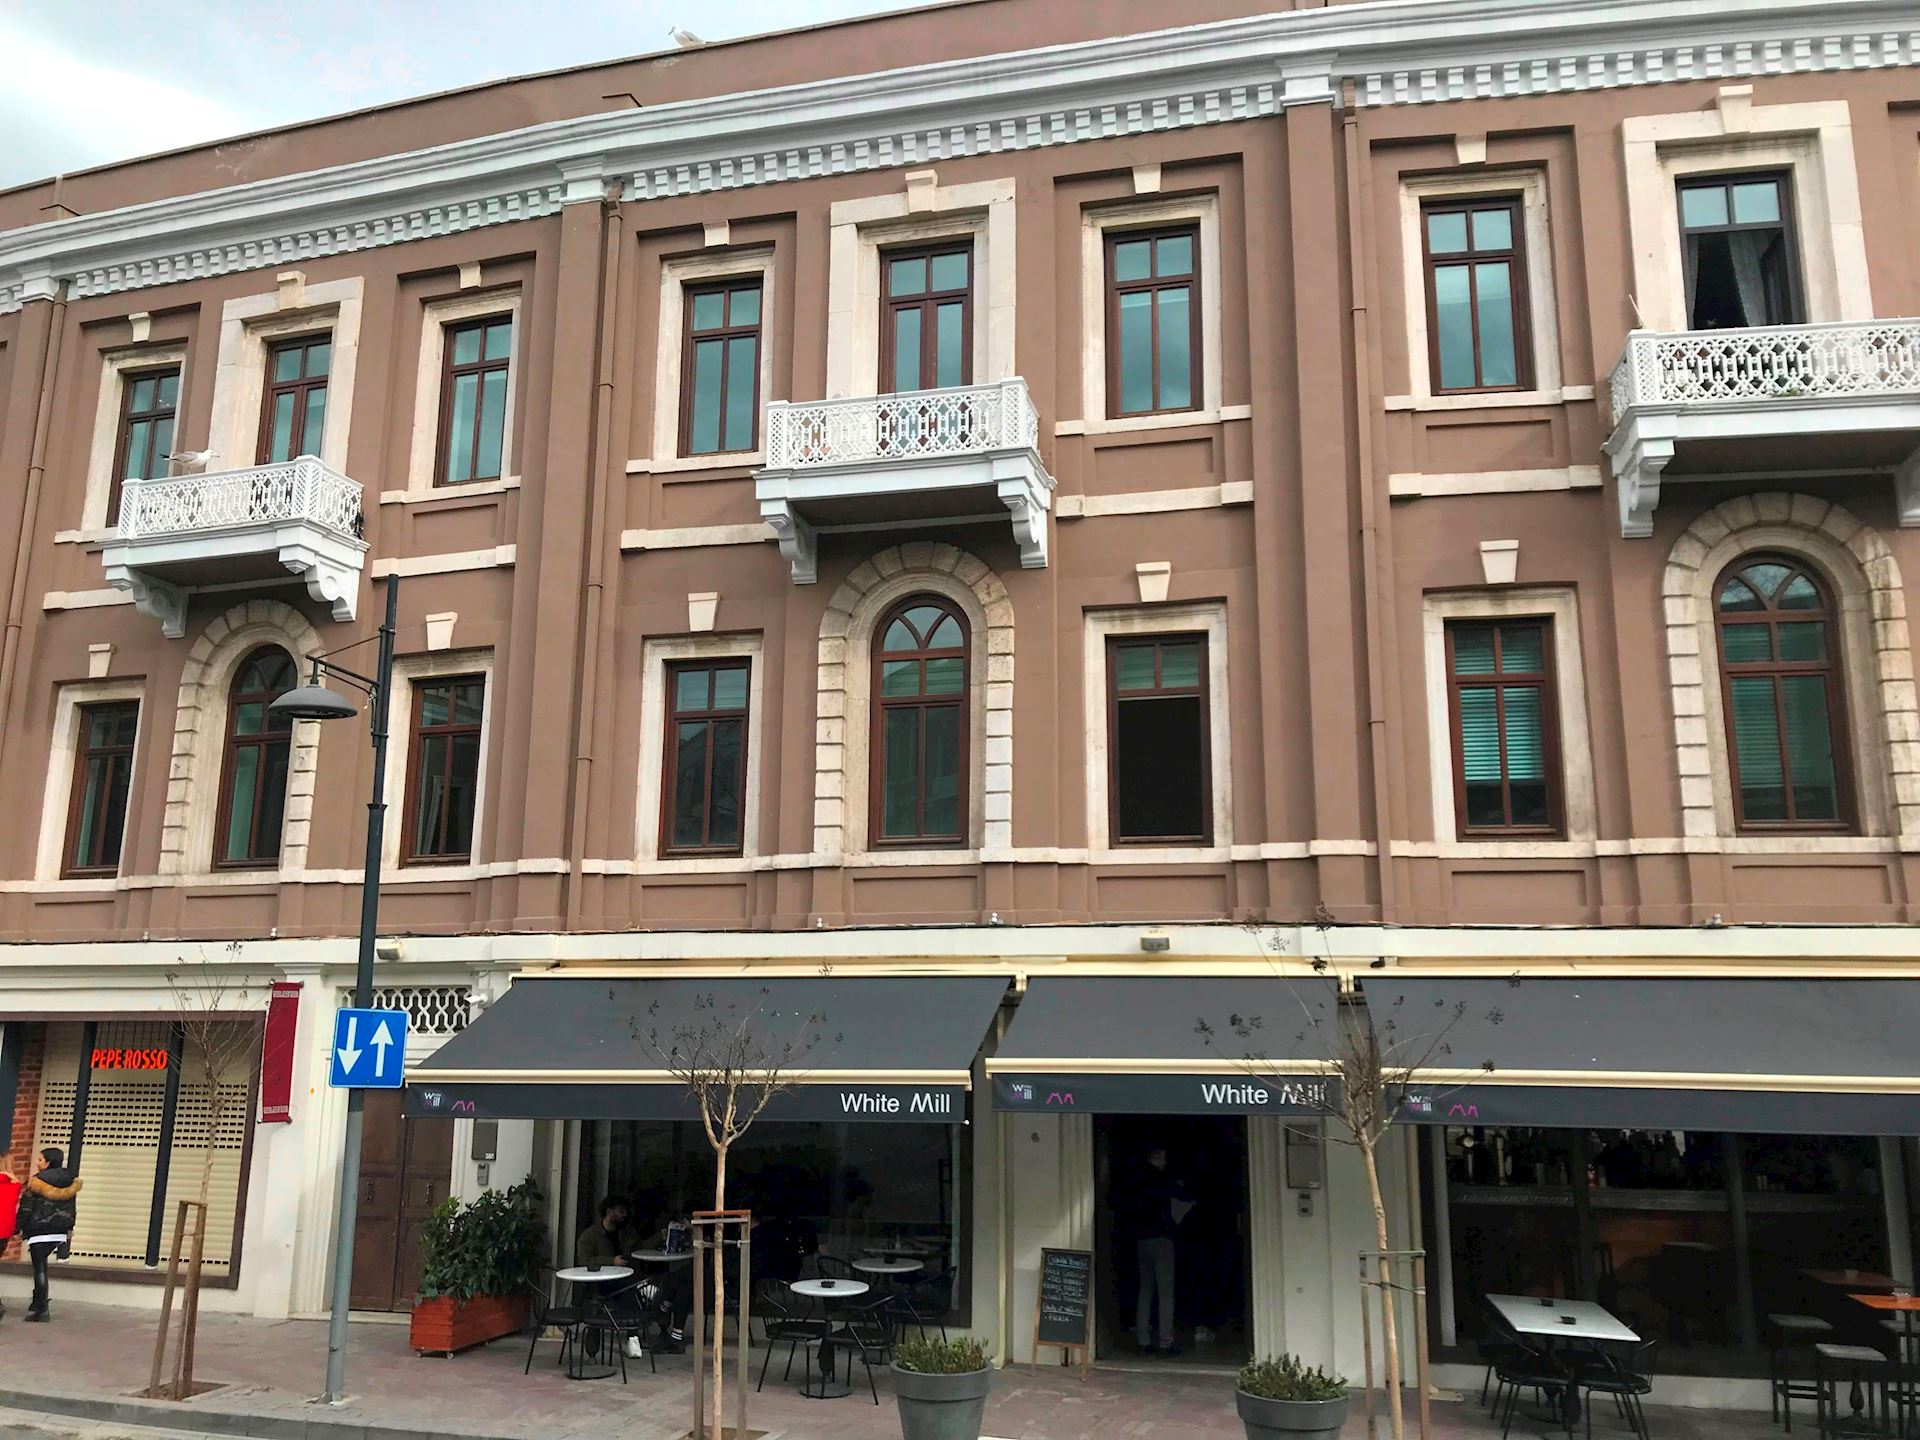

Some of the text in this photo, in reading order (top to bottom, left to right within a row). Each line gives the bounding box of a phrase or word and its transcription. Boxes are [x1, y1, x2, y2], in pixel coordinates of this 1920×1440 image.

[90, 1048, 168, 1070] PEPE ROSSO
[840, 1092, 950, 1113] White Mill
[1201, 1083, 1269, 1105] White
